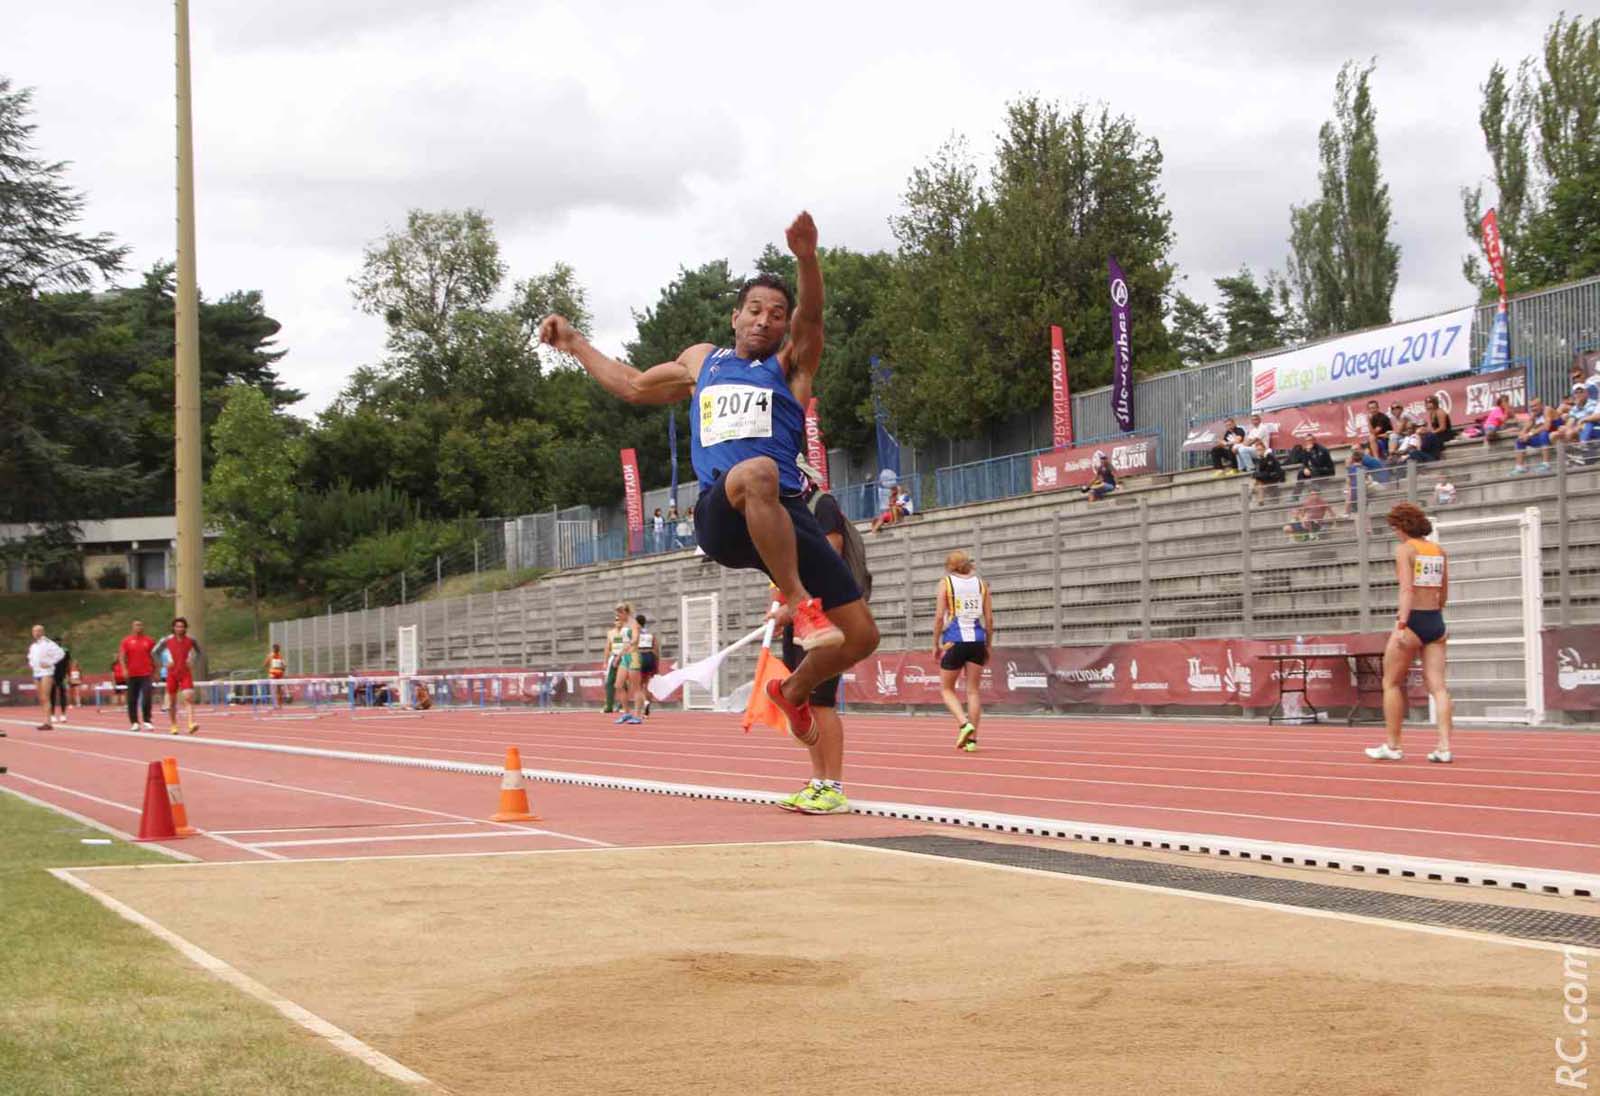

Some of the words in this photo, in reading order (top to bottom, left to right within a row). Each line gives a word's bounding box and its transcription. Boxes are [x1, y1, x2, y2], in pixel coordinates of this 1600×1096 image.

[1330, 345, 1392, 380] Daegu
[1397, 324, 1462, 365] 2017
[717, 391, 769, 418] 2074
